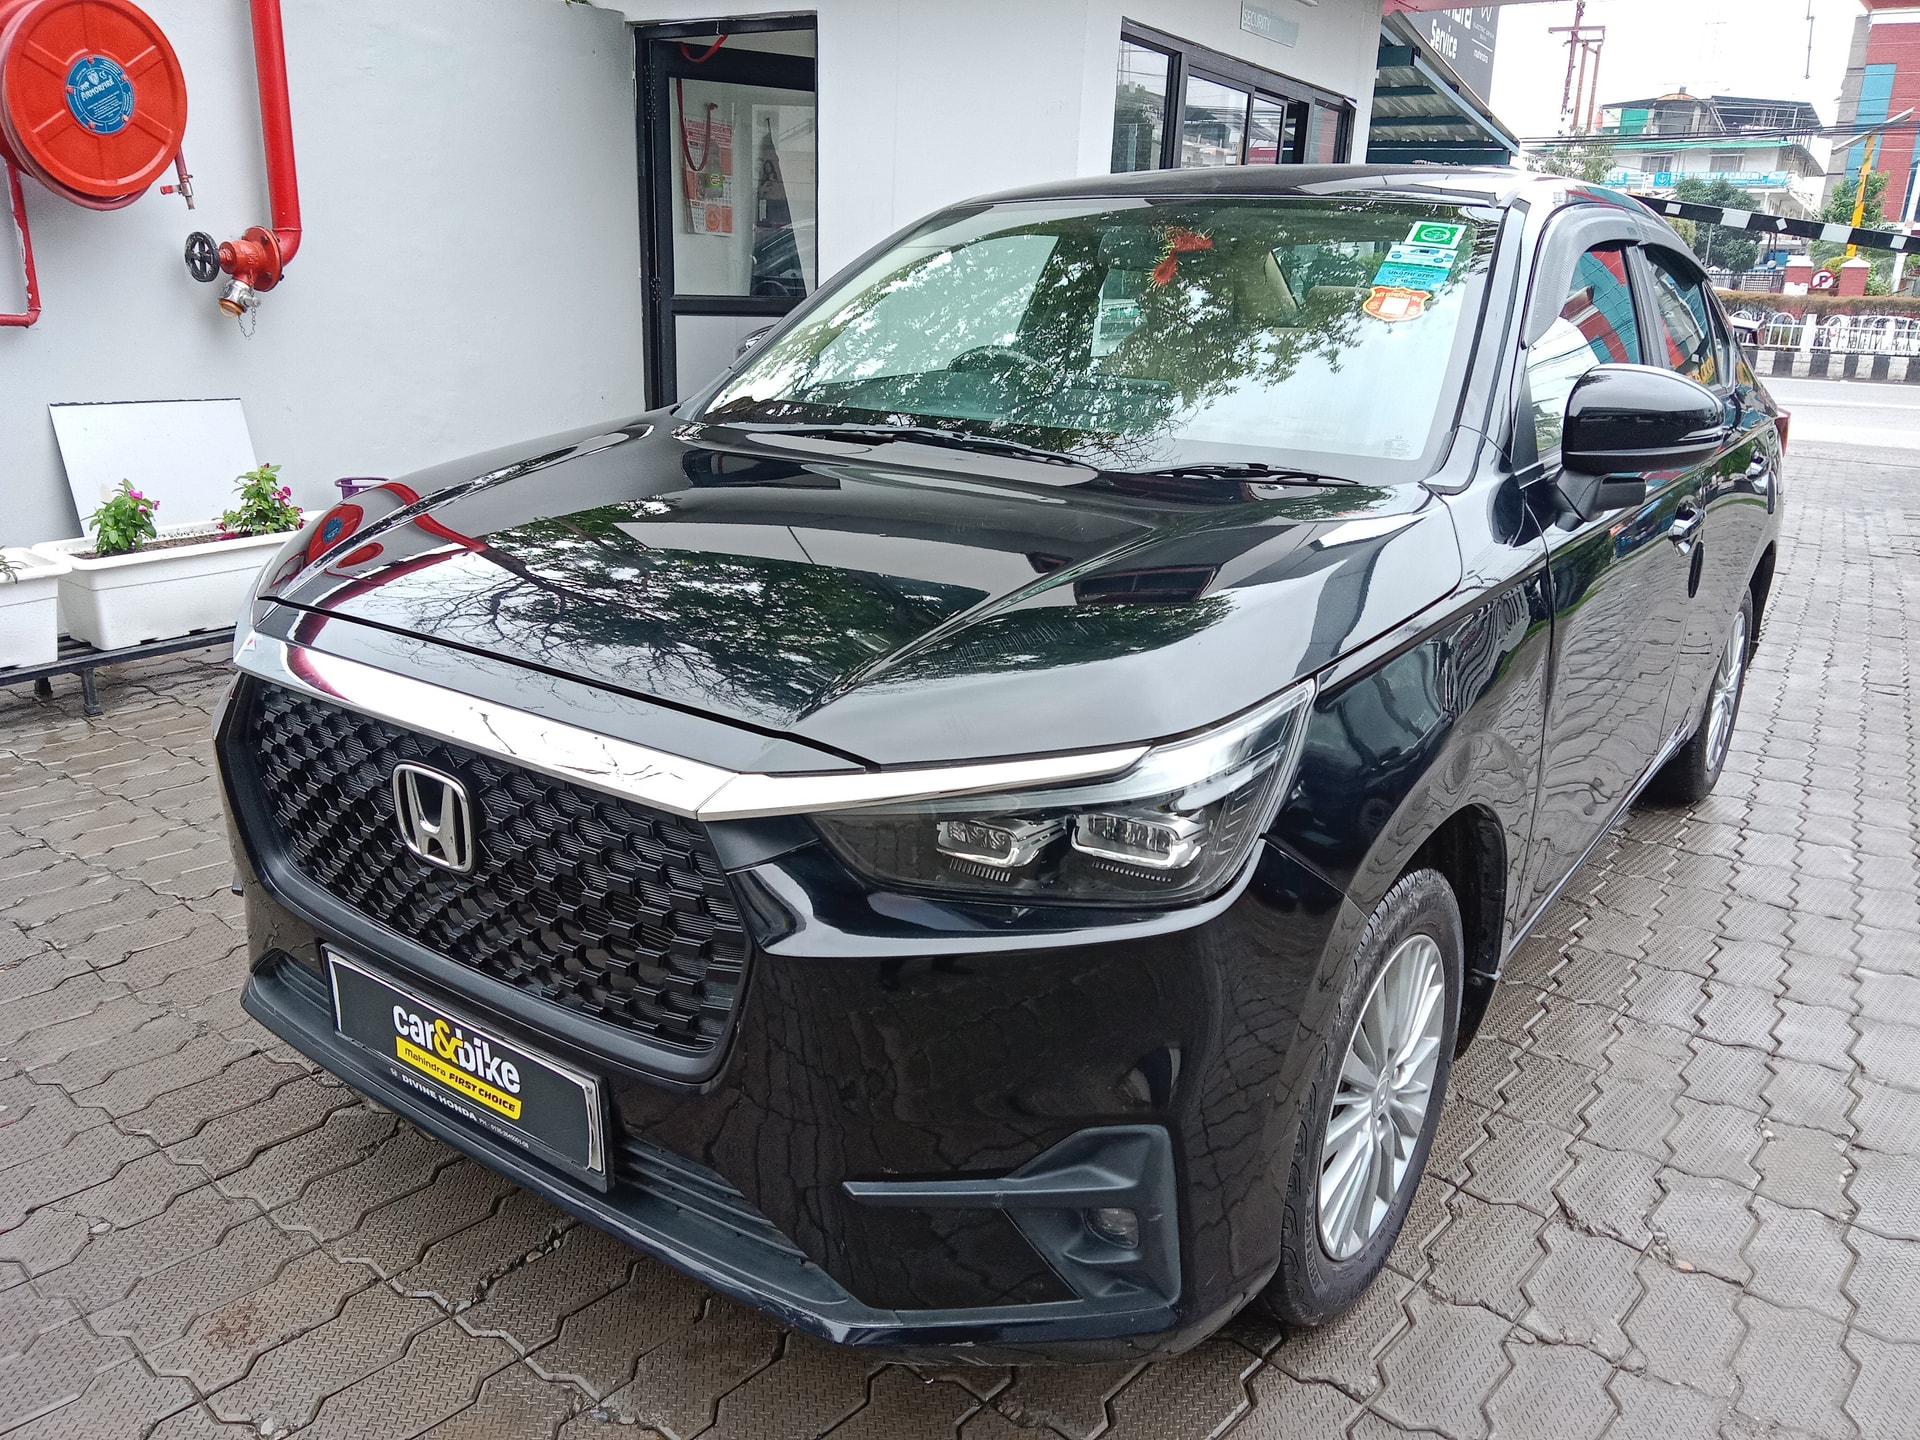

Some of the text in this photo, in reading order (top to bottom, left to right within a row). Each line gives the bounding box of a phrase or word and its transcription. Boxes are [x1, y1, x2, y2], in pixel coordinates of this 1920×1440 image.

[1244, 9, 1271, 32] SECURITY
[1429, 18, 1458, 60] Service
[392, 1005, 521, 1094] car&bike
[401, 1074, 478, 1122] DIVINE HONDA
[448, 1073, 478, 1092] FIRST
[478, 1087, 516, 1113] CHOICE
